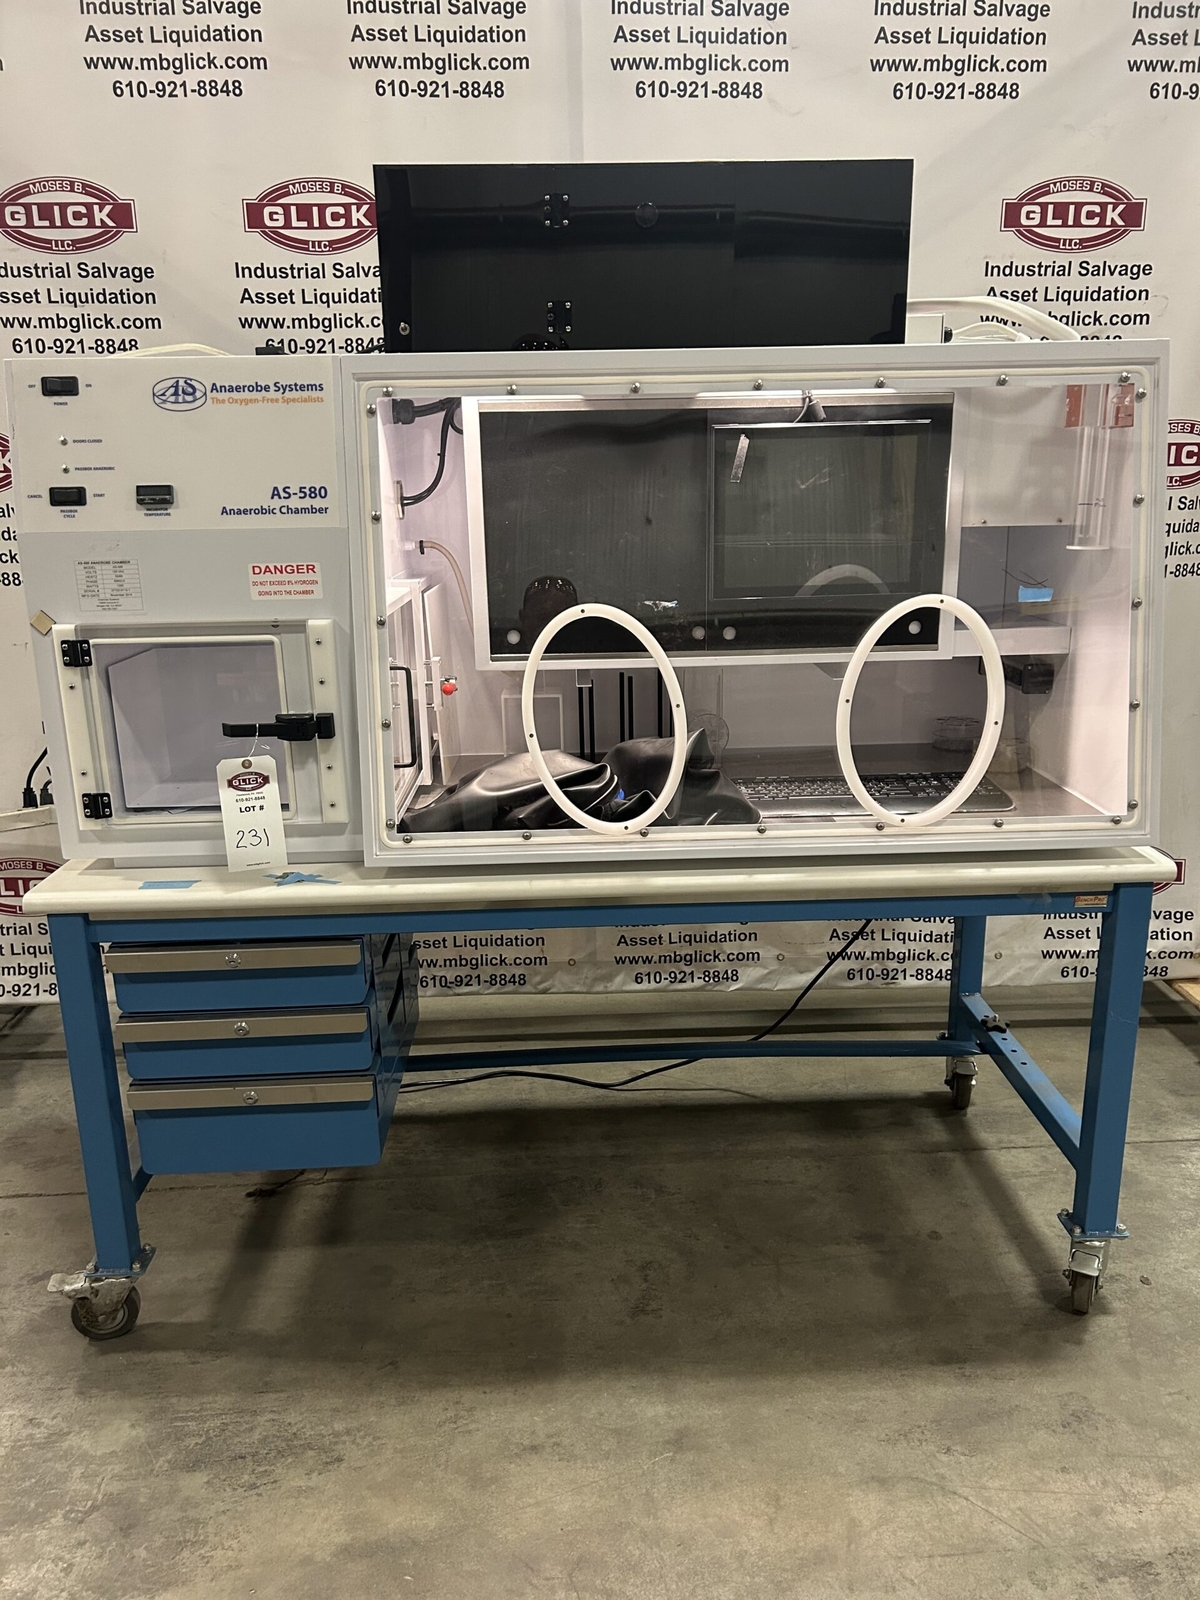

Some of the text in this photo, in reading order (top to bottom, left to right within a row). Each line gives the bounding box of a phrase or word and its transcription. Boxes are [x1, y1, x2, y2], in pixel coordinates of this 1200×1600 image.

[79, 0, 262, 18] Industrial Salvage
[346, 0, 527, 19] Industrial Salvage
[611, 0, 790, 21] Industrial Salvage
[873, 0, 1051, 21] Industrial Salvage
[1132, 1, 1200, 18] Industr
[85, 25, 263, 47] Asset Liquidation
[351, 25, 526, 47] Asset Liquidation
[613, 25, 788, 48] Asset Liquidation
[874, 26, 1047, 48] Asset Liquidation
[1131, 28, 1188, 46] Asset
[83, 53, 268, 74] www.mbglick.com
[349, 53, 530, 75] www.mbglick.com
[610, 54, 790, 75] www.mbglick.com
[869, 54, 1048, 76] www.mbglick.com
[112, 80, 243, 98] 610-921-8848
[375, 79, 505, 98] 610-921-8848
[635, 80, 763, 99] 610-921-8848
[892, 82, 1020, 99] 610-921-8848
[29, 180, 86, 194] MOSES B.
[289, 181, 345, 195] MOSES B.
[1050, 180, 1104, 193] MOSES B.
[4, 204, 117, 227] GLICK
[263, 204, 372, 228] GLICK
[1020, 204, 1127, 226] GLICK
[51, 240, 76, 251] LLC.
[308, 240, 332, 251] LLC.
[1059, 238, 1082, 249] LLC.
[0, 262, 155, 283] dustrial Salvage
[235, 262, 381, 279] Industrial Salva
[984, 261, 1153, 280] Industrial Salvage
[0, 288, 157, 308] sset Liquidation
[240, 288, 382, 308] Asset Liquidati
[986, 286, 1150, 305] Asset Liquidation
[0, 313, 162, 333] ww.mbglick.com
[239, 313, 383, 333] www.mbglick.c
[12, 338, 139, 354] 610-921-8848
[210, 381, 324, 394] Anaerobe Systems
[210, 395, 325, 406] The Oxygen-Free Specialists
[1168, 423, 1191, 433] SES
[1167, 476, 1182, 486] LC.
[270, 486, 328, 500] AS-580
[221, 504, 329, 516] Anaerobic Chamber
[252, 564, 316, 575] DANGER
[232, 776, 264, 787] GLICK
[239, 805, 257, 813] LOT
[236, 828, 270, 848] 231
[36, 863, 46, 871] B.
[617, 929, 758, 946] Asset Liquidation
[829, 928, 954, 944] Asset Liquidati
[1043, 926, 1091, 939] Asset
[413, 934, 545, 950] sset Liquidation
[614, 950, 761, 966] www.mbglick.com
[826, 949, 954, 964] www.mbglick.c
[420, 973, 527, 988] 610-921-8848
[635, 969, 739, 984] 610-921-8848
[847, 968, 952, 981] 610-921-8848
